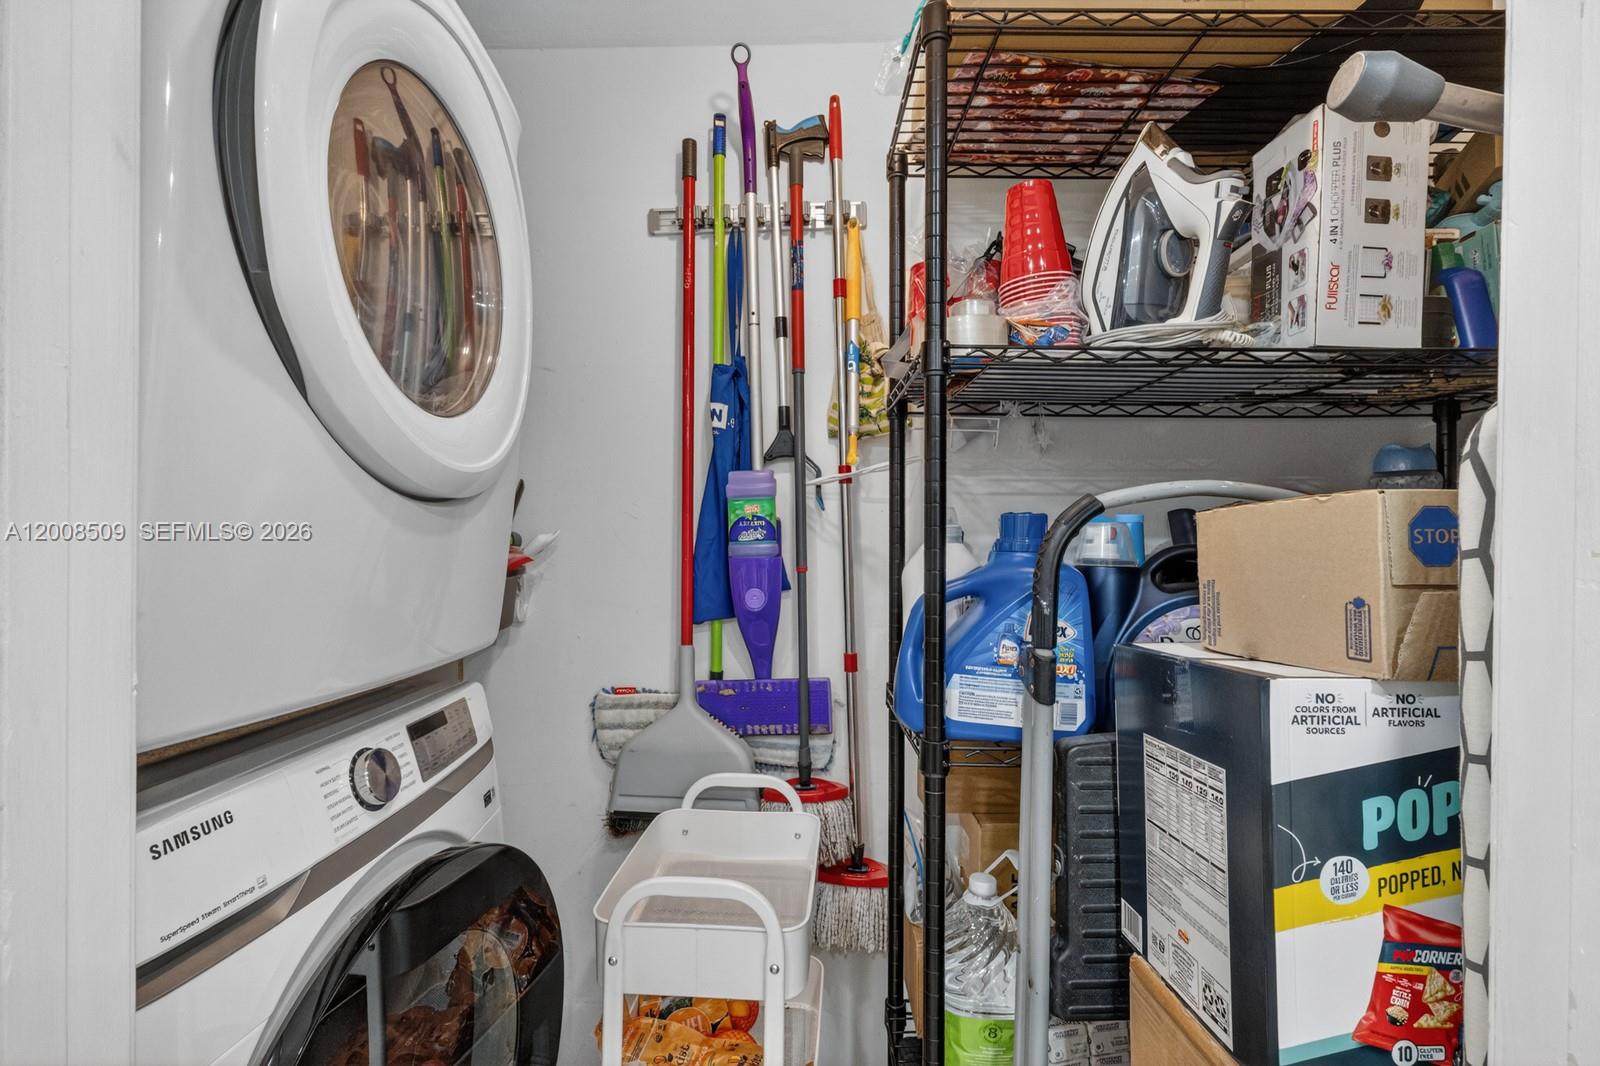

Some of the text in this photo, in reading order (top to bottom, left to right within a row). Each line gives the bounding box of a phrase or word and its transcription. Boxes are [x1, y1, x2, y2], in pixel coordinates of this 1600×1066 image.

[1333, 140, 1342, 167] PLUS
[1330, 225, 1339, 236] IN
[1414, 528, 1459, 545] STOP
[1315, 693, 1336, 705] NO
[1395, 693, 1417, 705] NO
[1294, 705, 1357, 714] COLORS FROM
[1372, 707, 1441, 719] ARTIFICIAL
[1291, 715, 1361, 726] ARTIFICIAL
[1388, 719, 1425, 728] FLAVORS
[1306, 727, 1346, 735] SOURCES
[149, 810, 234, 861] SAMSUNG
[1332, 858, 1353, 877] 140
[1377, 865, 1446, 898] POPPED,
[1330, 881, 1359, 896] OR LESS
[1398, 1045, 1413, 1063] 10
